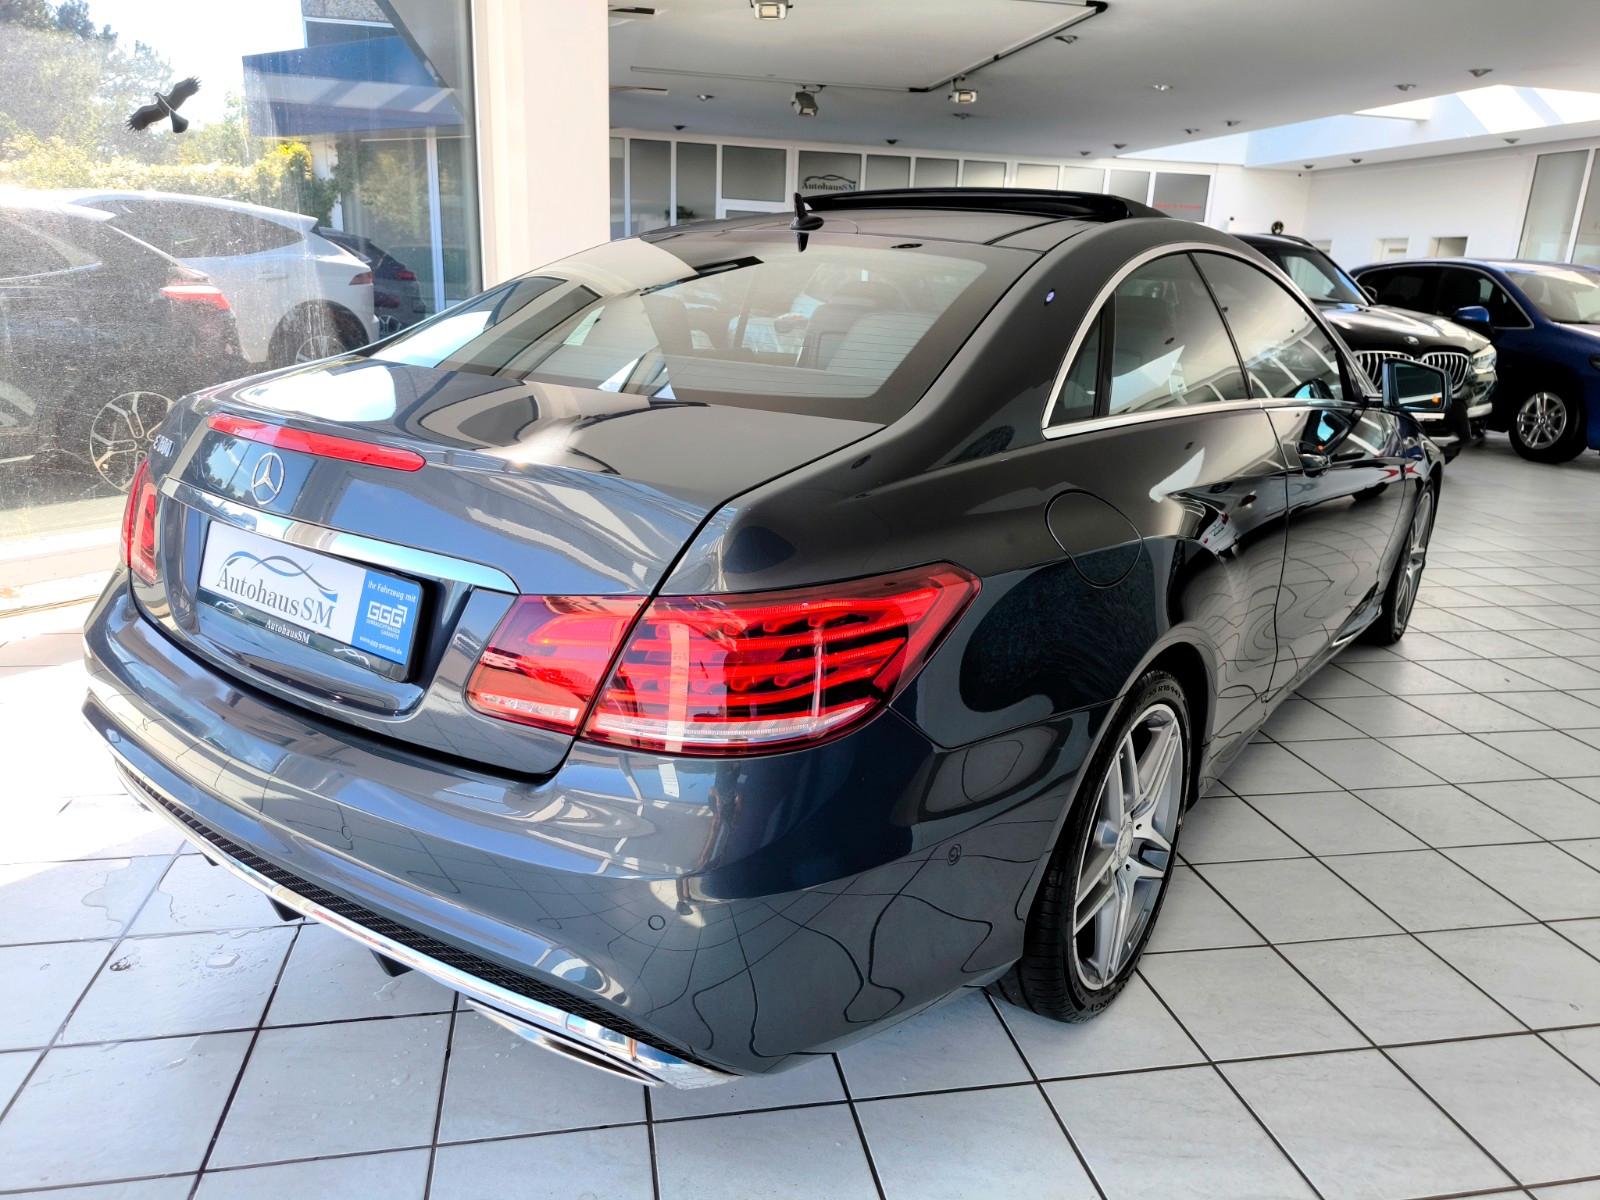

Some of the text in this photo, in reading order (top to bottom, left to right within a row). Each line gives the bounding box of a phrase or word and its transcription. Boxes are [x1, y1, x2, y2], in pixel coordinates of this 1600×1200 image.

[802, 182, 856, 192] AutohausSM
[368, 580, 417, 603] Ihr Fahrzeug mit
[265, 619, 310, 644] AutohausSM
